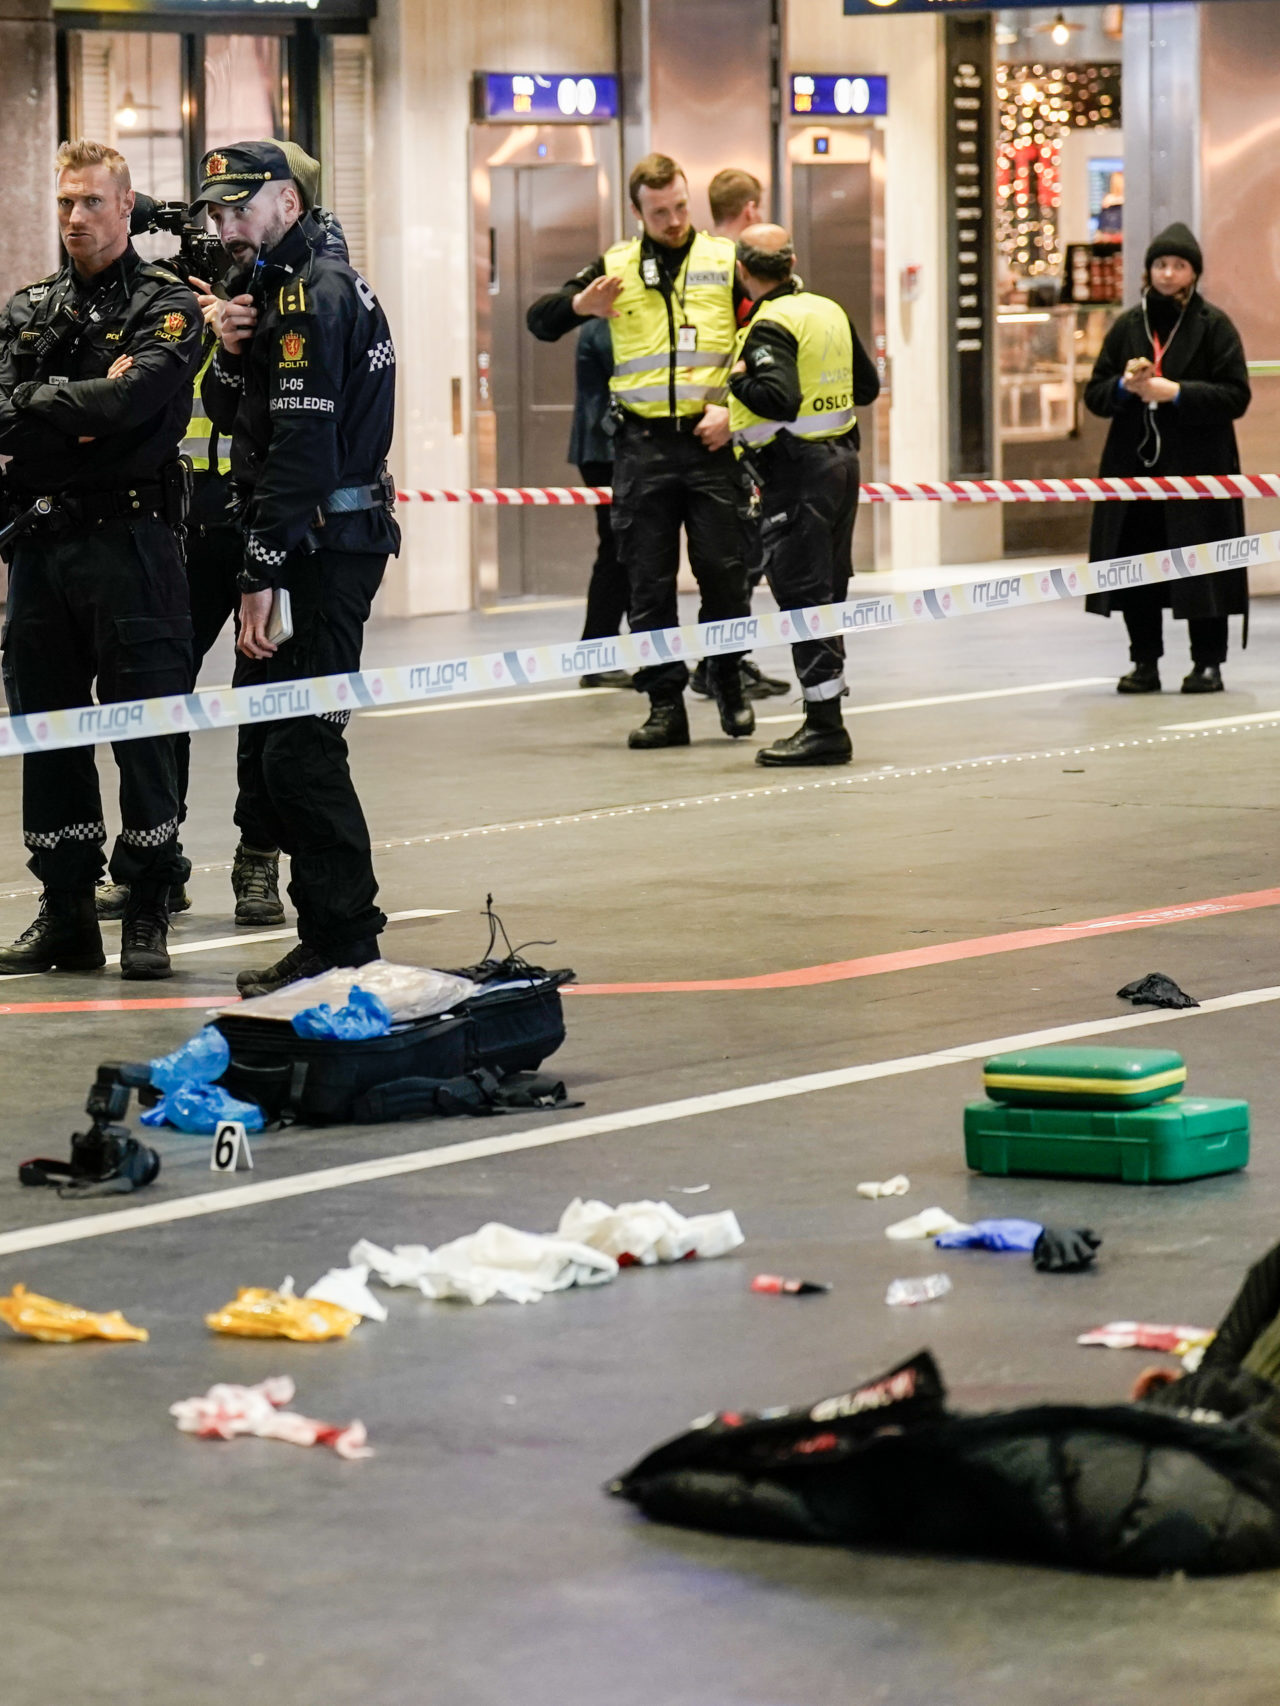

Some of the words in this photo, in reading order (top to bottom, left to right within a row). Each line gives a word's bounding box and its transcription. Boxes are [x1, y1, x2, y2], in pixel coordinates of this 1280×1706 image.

[279, 360, 308, 369] POLITI
[280, 378, 304, 390] U-05
[813, 394, 848, 411] OSLO
[215, 1125, 236, 1169] 6
